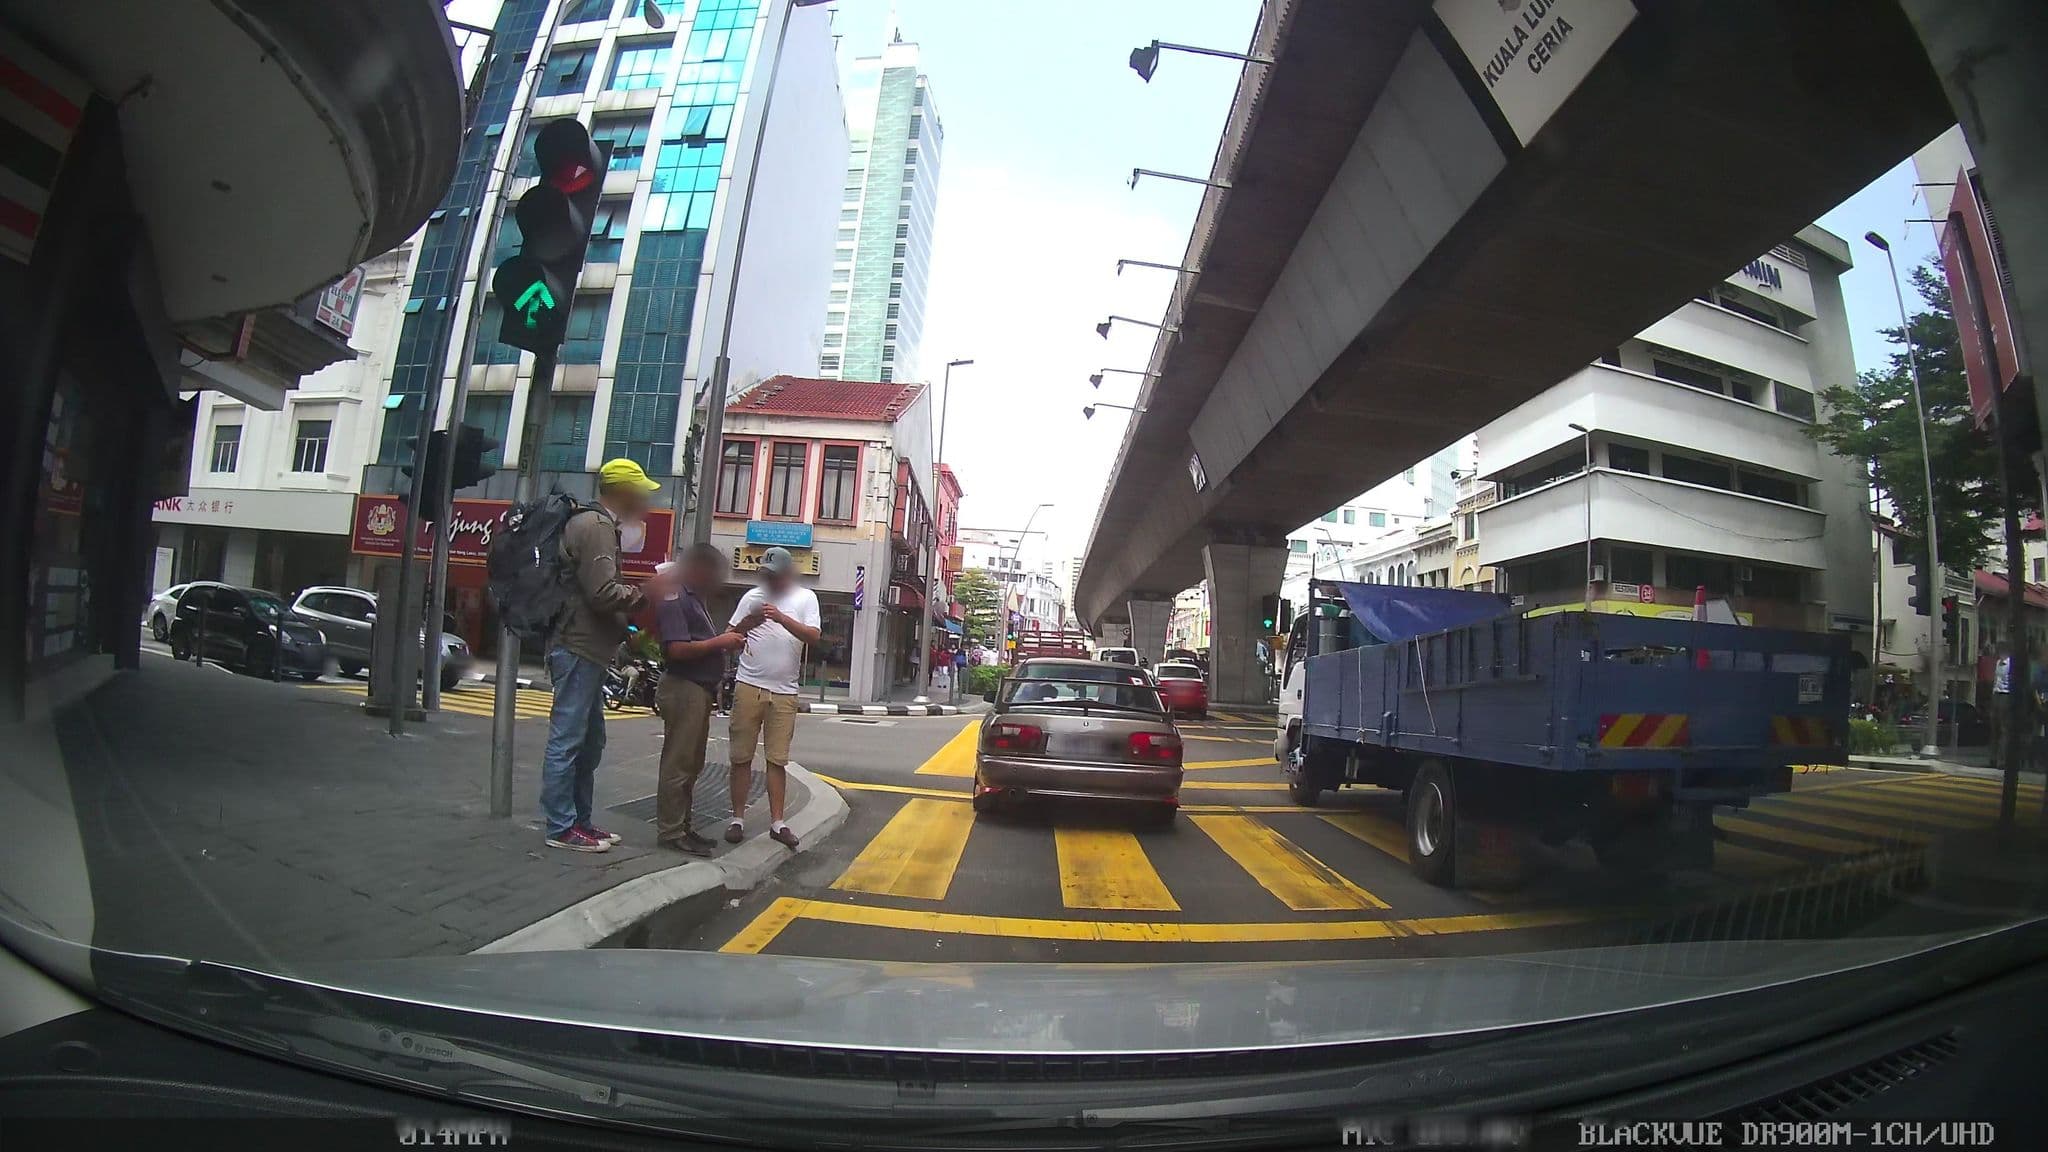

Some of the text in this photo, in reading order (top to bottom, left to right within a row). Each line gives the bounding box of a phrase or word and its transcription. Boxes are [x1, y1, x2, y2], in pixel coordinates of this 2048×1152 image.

[1483, 0, 1556, 88] KUALA LU
[1527, 16, 1573, 74] CERIA
[153, 498, 181, 512] ANK
[186, 500, 233, 514] 大众银行
